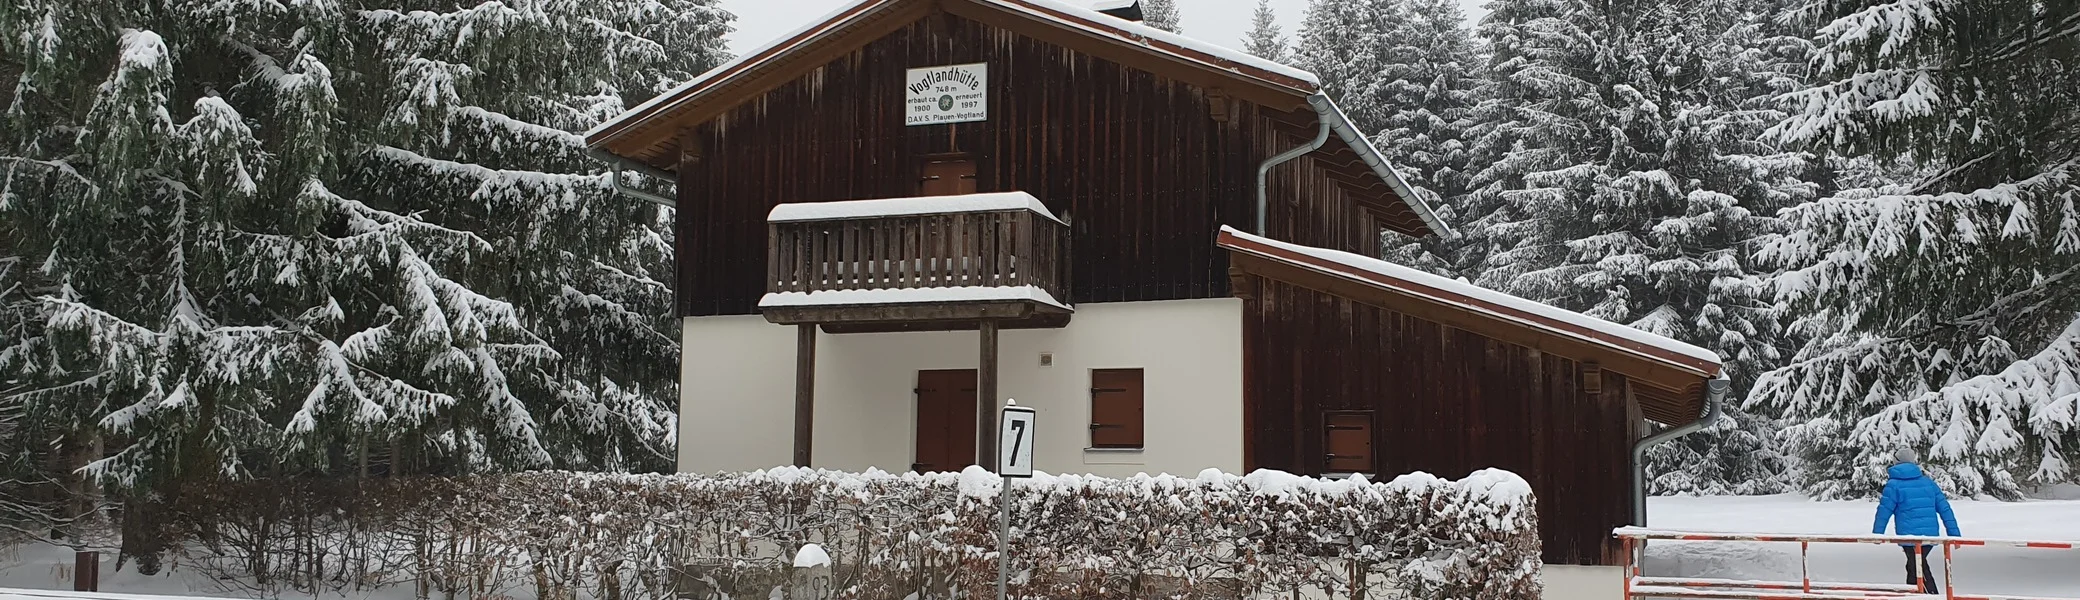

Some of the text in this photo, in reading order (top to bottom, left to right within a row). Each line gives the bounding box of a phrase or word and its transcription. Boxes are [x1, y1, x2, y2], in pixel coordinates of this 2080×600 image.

[909, 67, 979, 95] Vogtlandhütte
[935, 85, 949, 93] 748
[908, 96, 927, 104] erbaut
[955, 92, 982, 100] erneuert
[1010, 420, 1025, 466] 7
